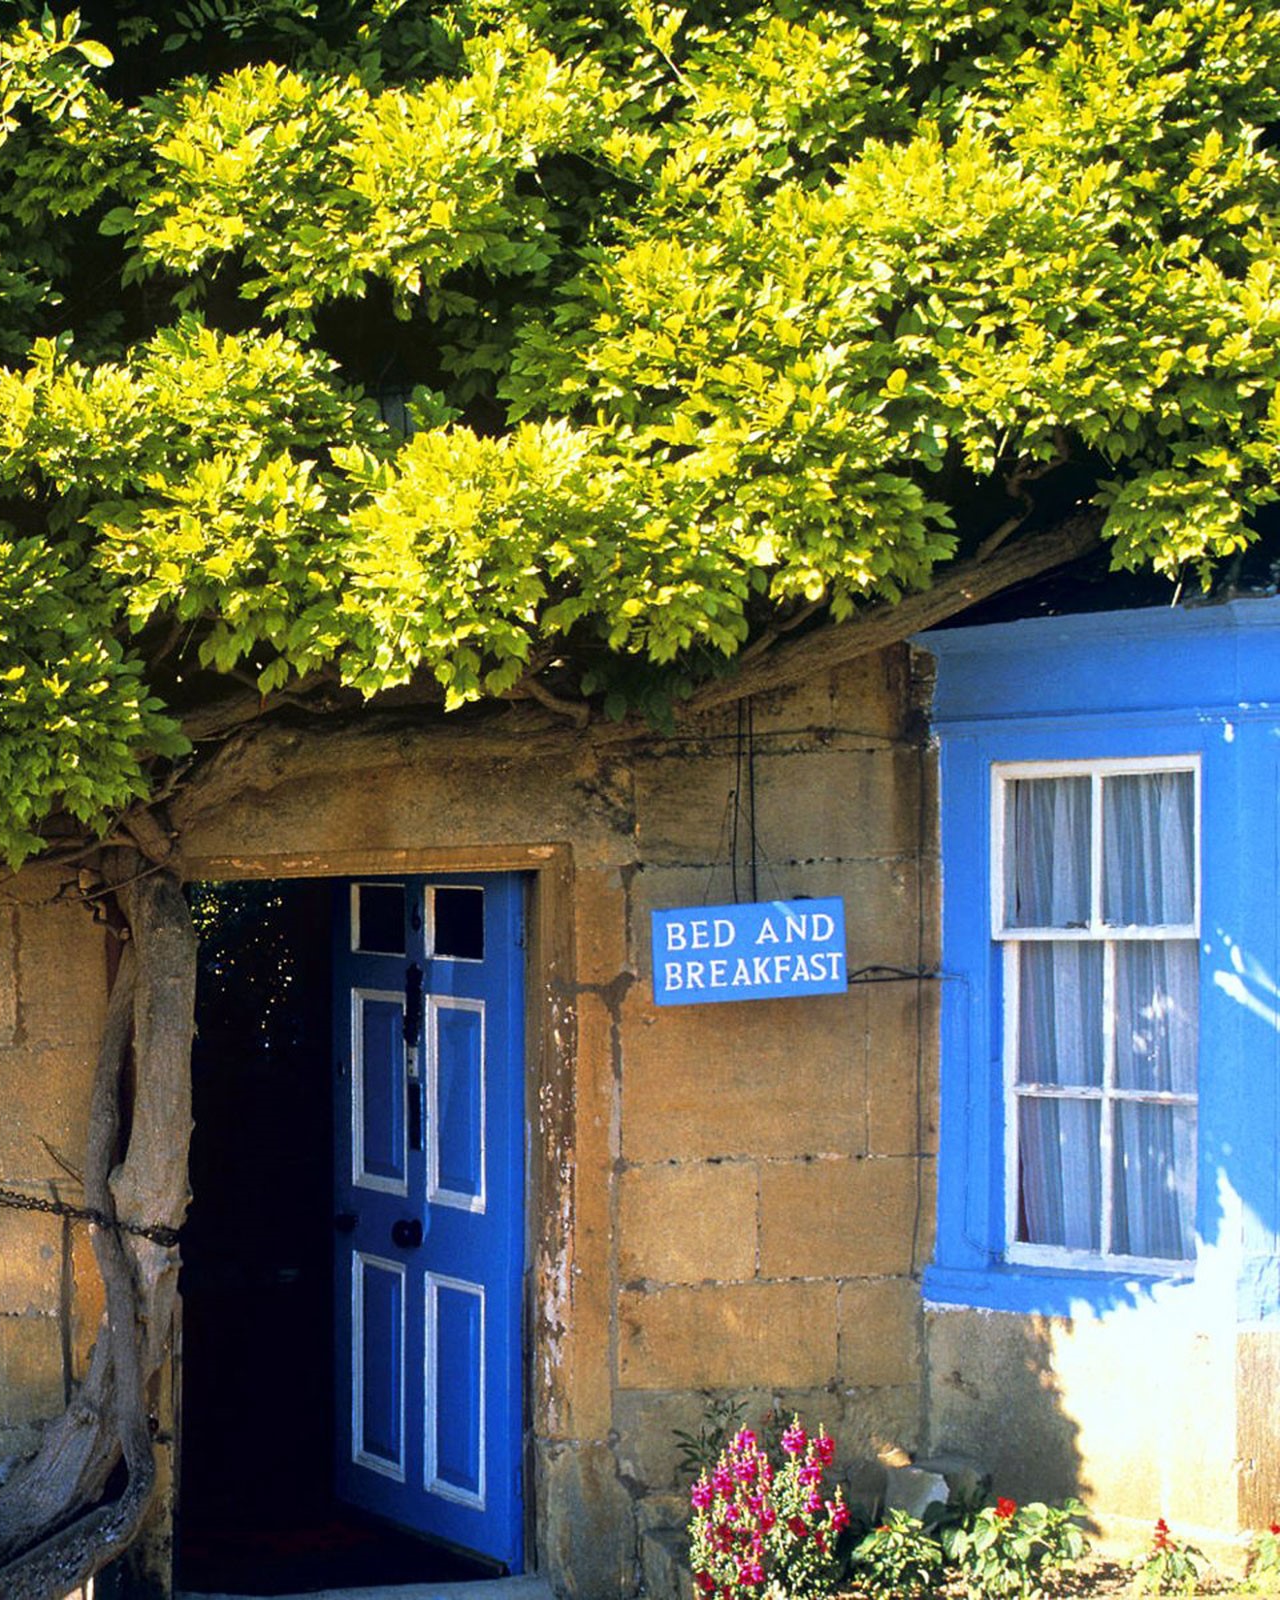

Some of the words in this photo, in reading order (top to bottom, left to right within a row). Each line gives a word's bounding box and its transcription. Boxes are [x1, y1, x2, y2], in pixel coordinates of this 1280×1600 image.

[665, 919, 736, 951] BED
[754, 913, 835, 945] AND
[664, 952, 844, 992] BREAKFAST
